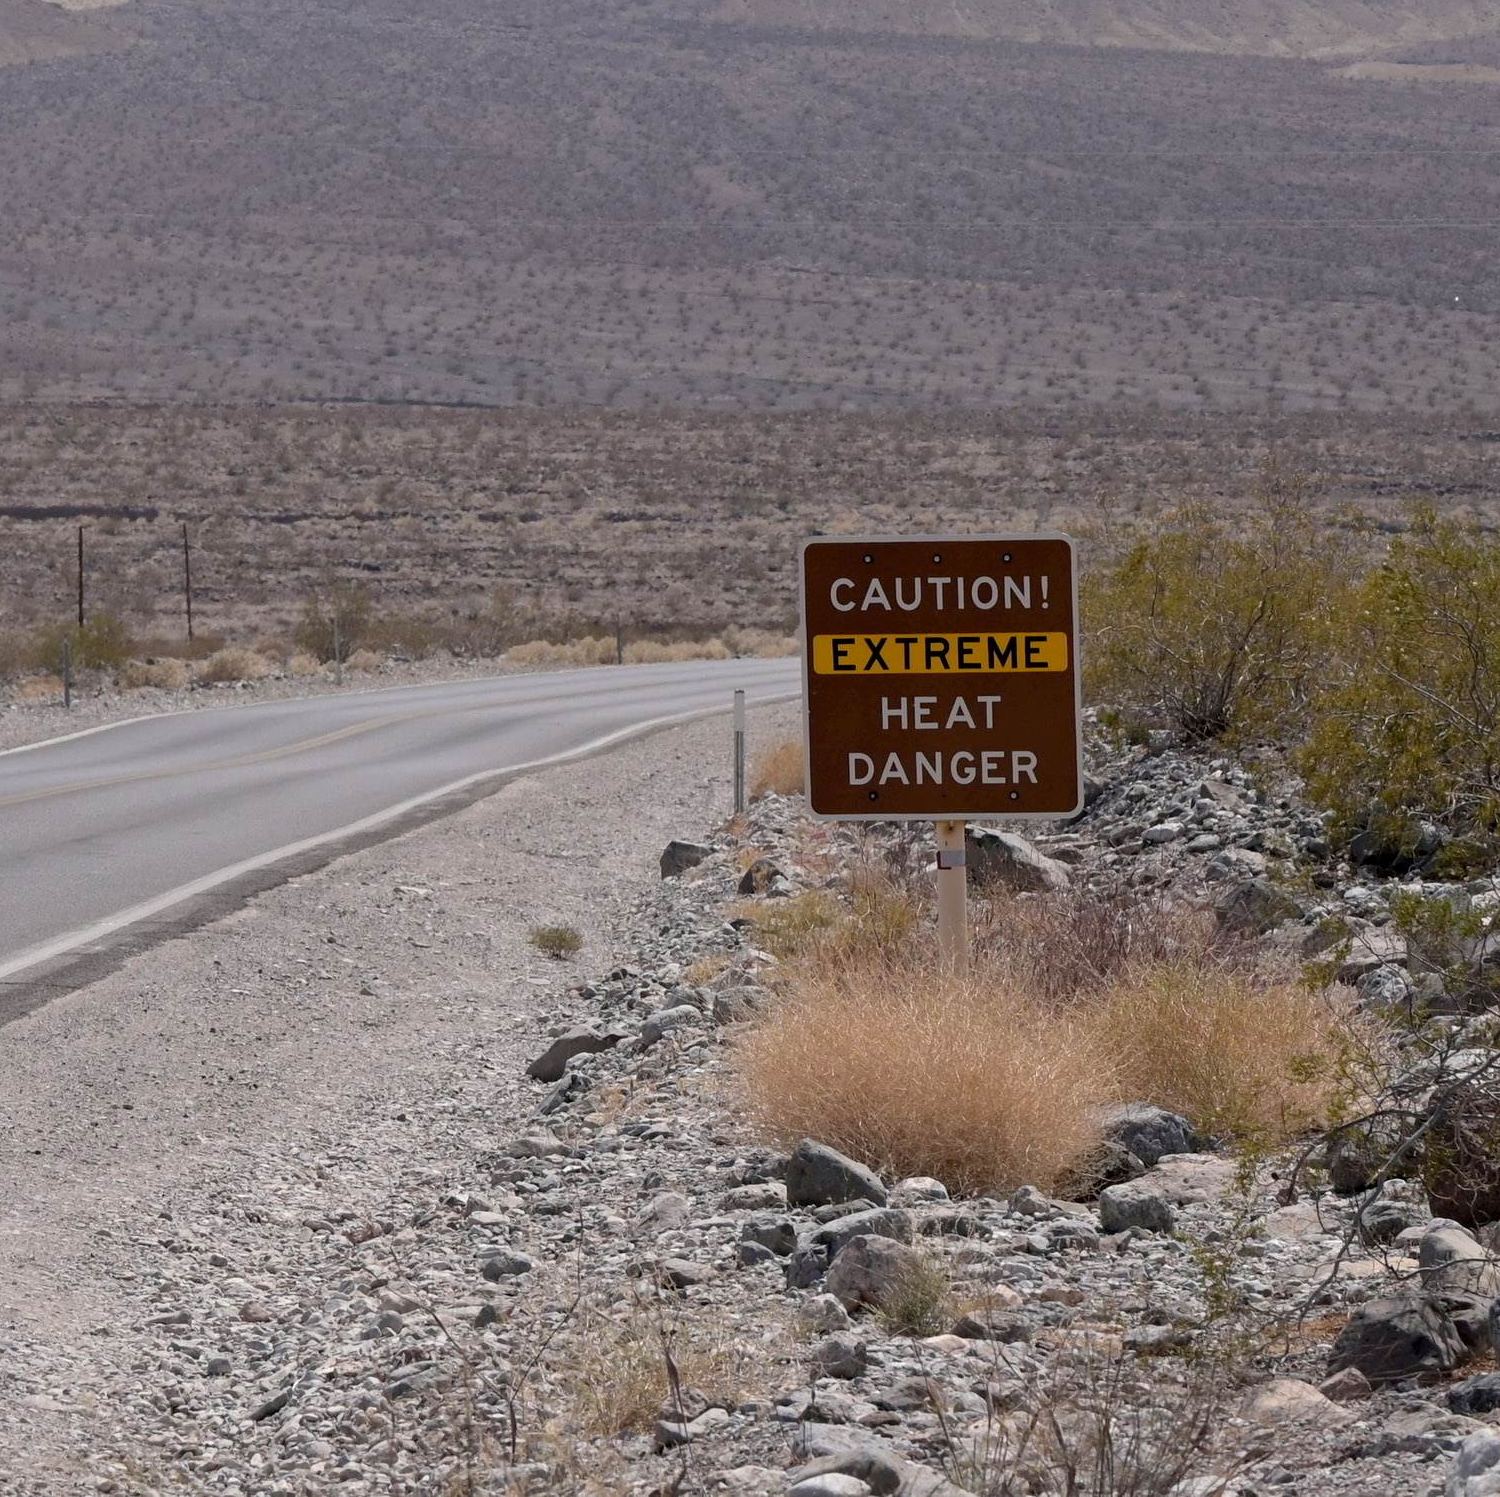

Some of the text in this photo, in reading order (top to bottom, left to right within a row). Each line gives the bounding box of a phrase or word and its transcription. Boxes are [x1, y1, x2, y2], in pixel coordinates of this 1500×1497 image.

[830, 575, 1048, 612] CAUTION!
[831, 635, 1049, 671] EXTREME
[881, 695, 1002, 730] HEAT
[848, 750, 1038, 786] DANGER
